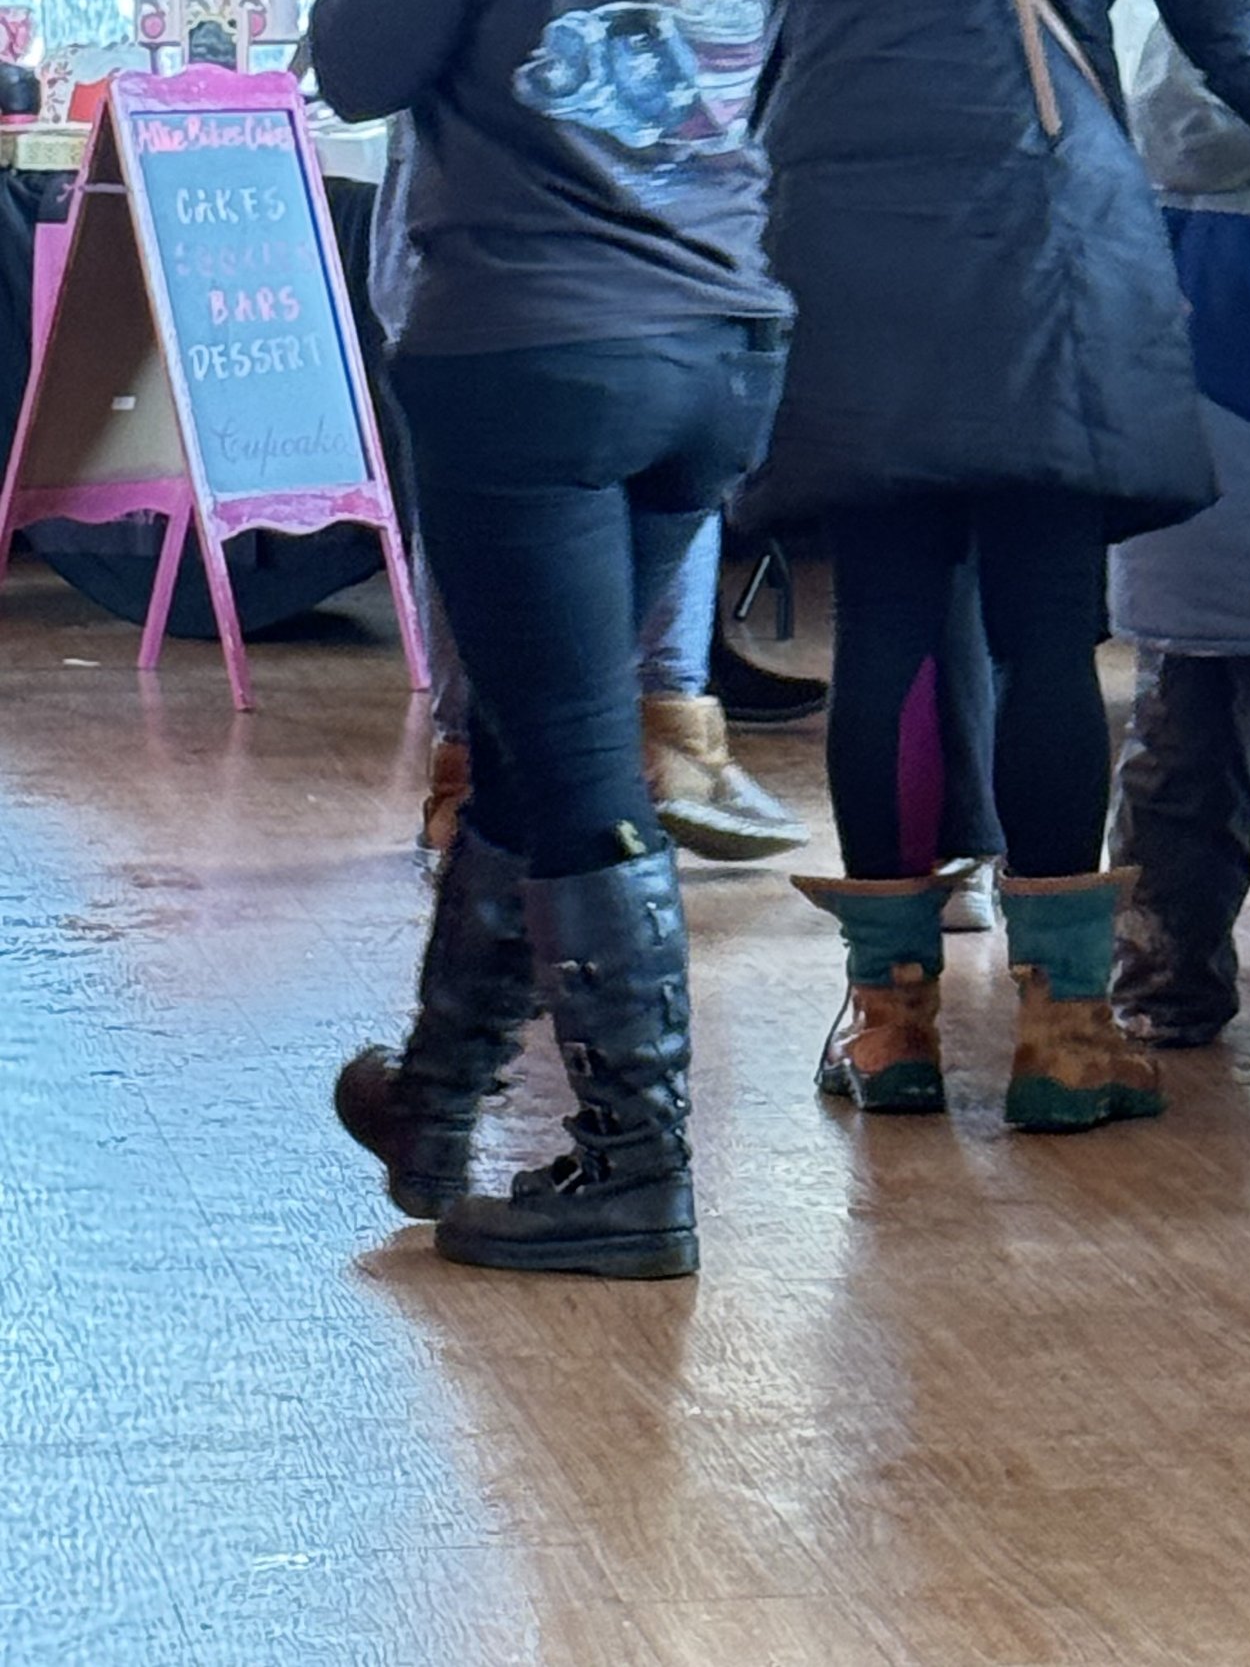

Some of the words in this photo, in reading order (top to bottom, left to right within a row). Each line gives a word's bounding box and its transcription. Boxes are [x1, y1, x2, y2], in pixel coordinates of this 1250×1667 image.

[176, 187, 286, 225] CAKES
[209, 285, 301, 325] BARS
[188, 334, 322, 381] DESSERT
